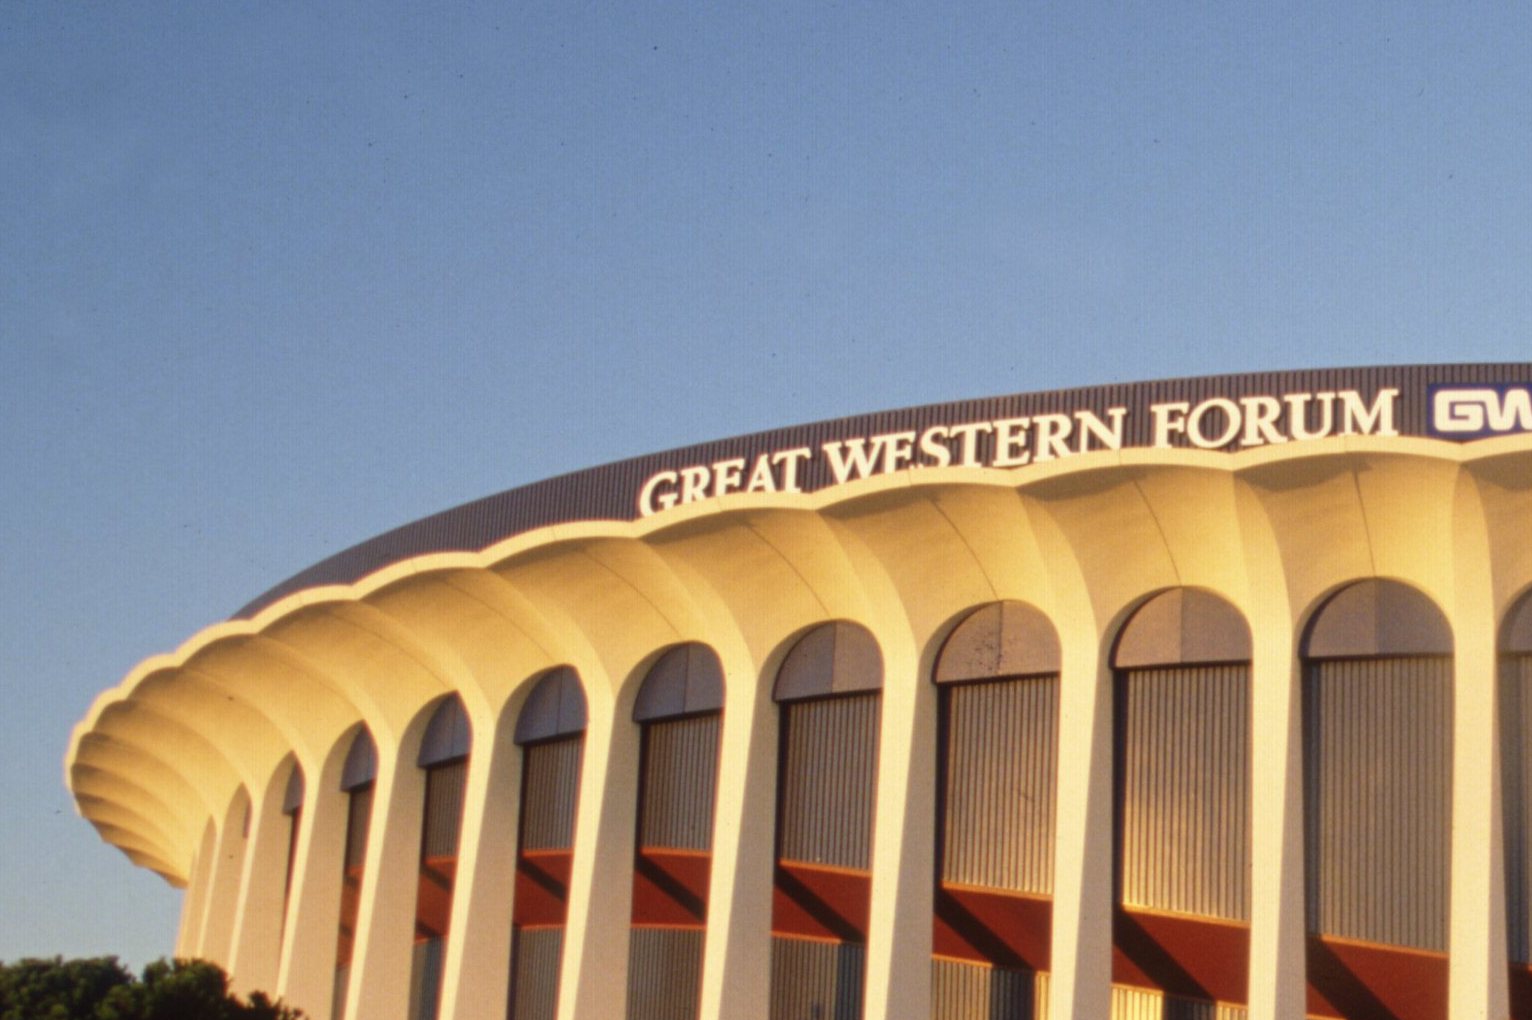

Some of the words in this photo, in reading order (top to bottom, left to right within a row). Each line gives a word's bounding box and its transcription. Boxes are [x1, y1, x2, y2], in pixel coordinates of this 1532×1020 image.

[639, 447, 812, 517] GREAT
[822, 408, 1126, 485] WESTERN
[1151, 389, 1398, 449] FORUM
